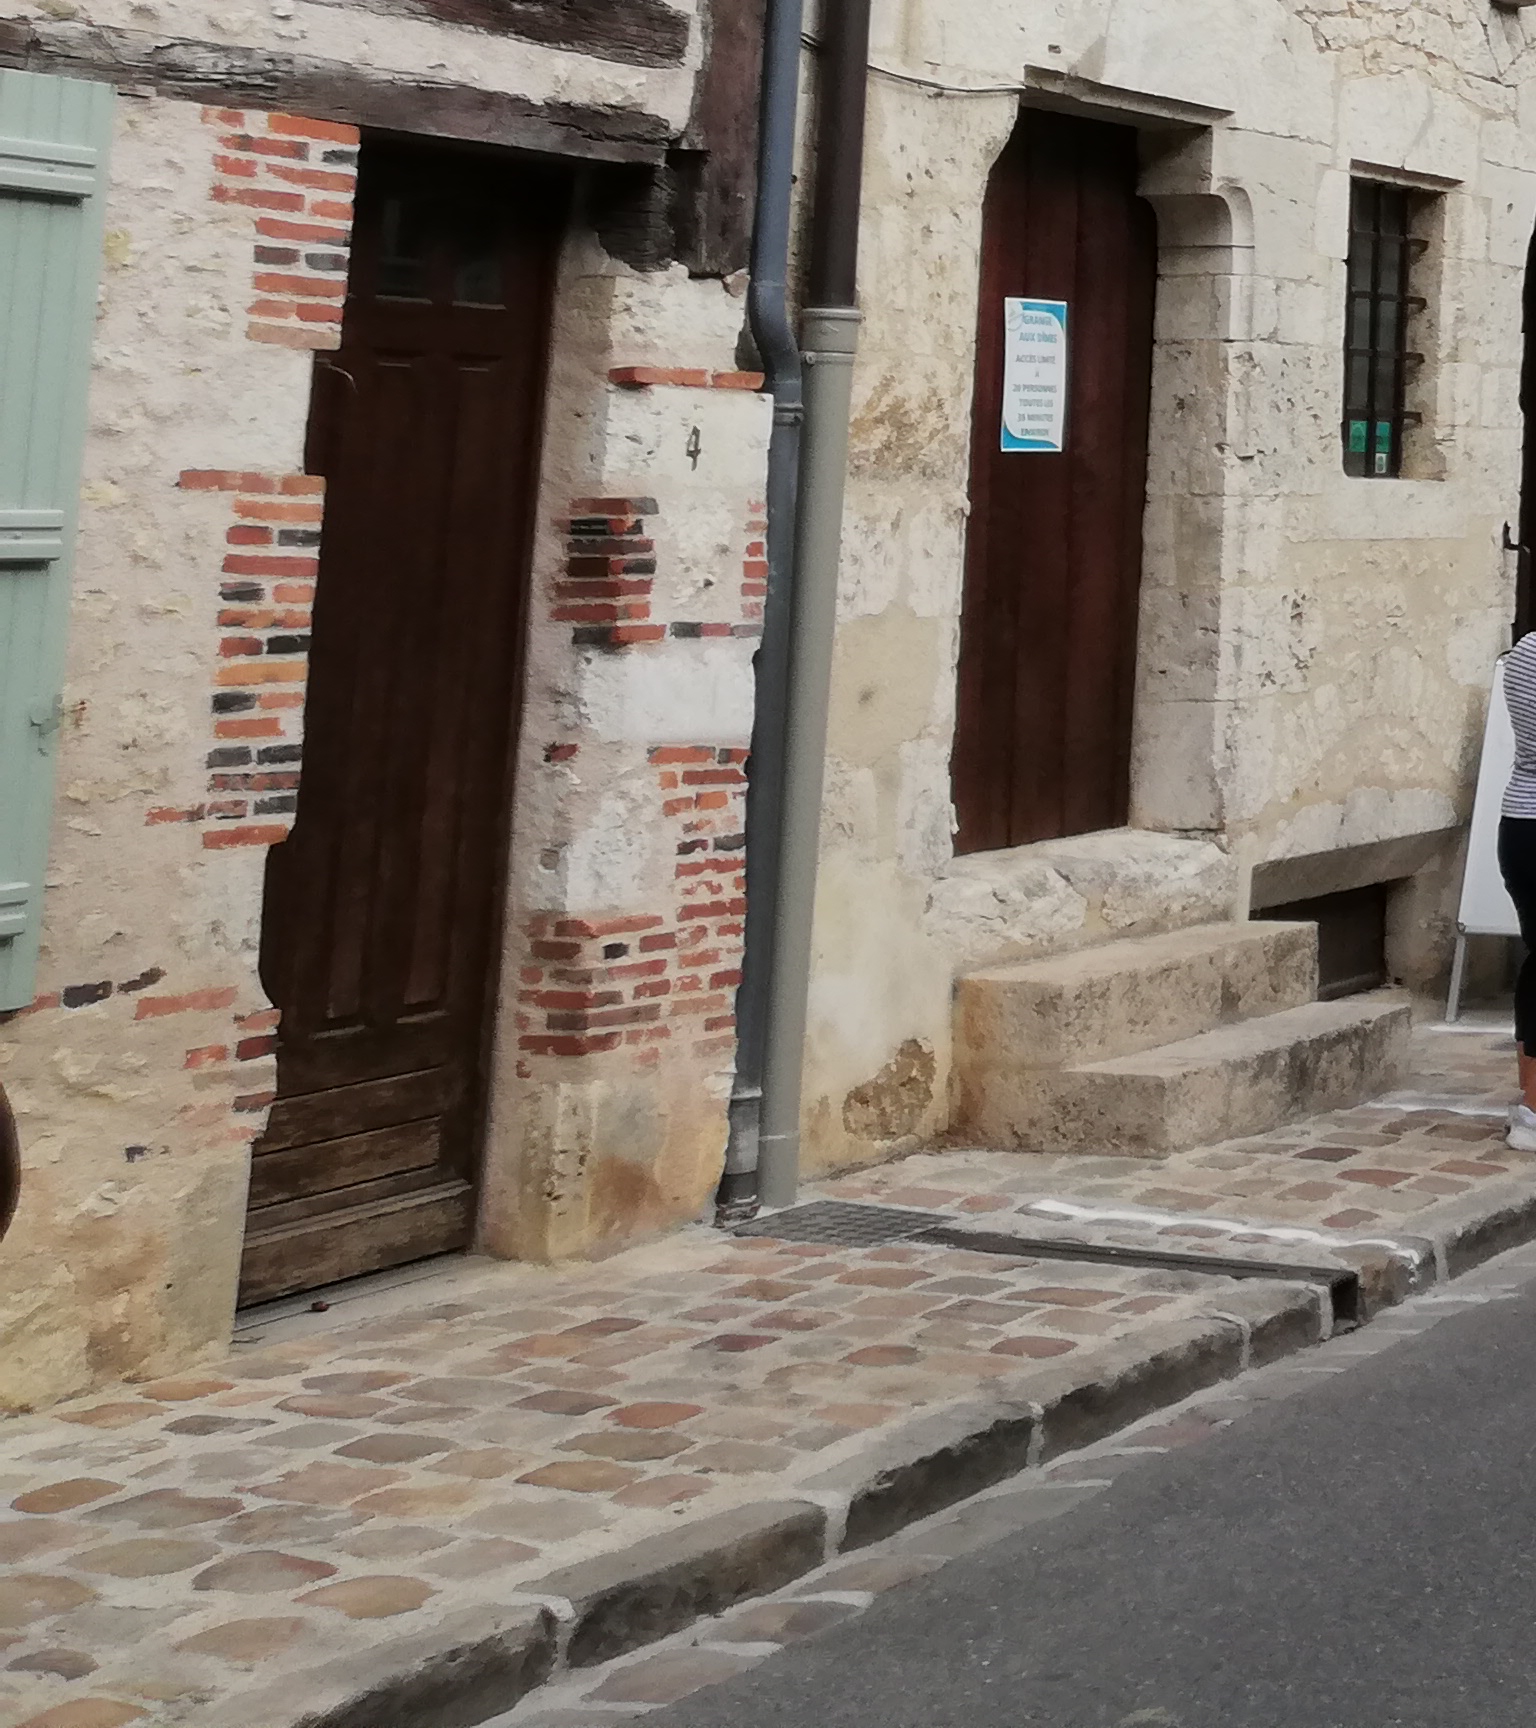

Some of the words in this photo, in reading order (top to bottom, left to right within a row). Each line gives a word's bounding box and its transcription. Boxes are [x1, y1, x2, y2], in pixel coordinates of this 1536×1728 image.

[1024, 315, 1053, 326] GRANGE
[1018, 333, 1036, 342] AUX
[685, 424, 702, 472] 4
